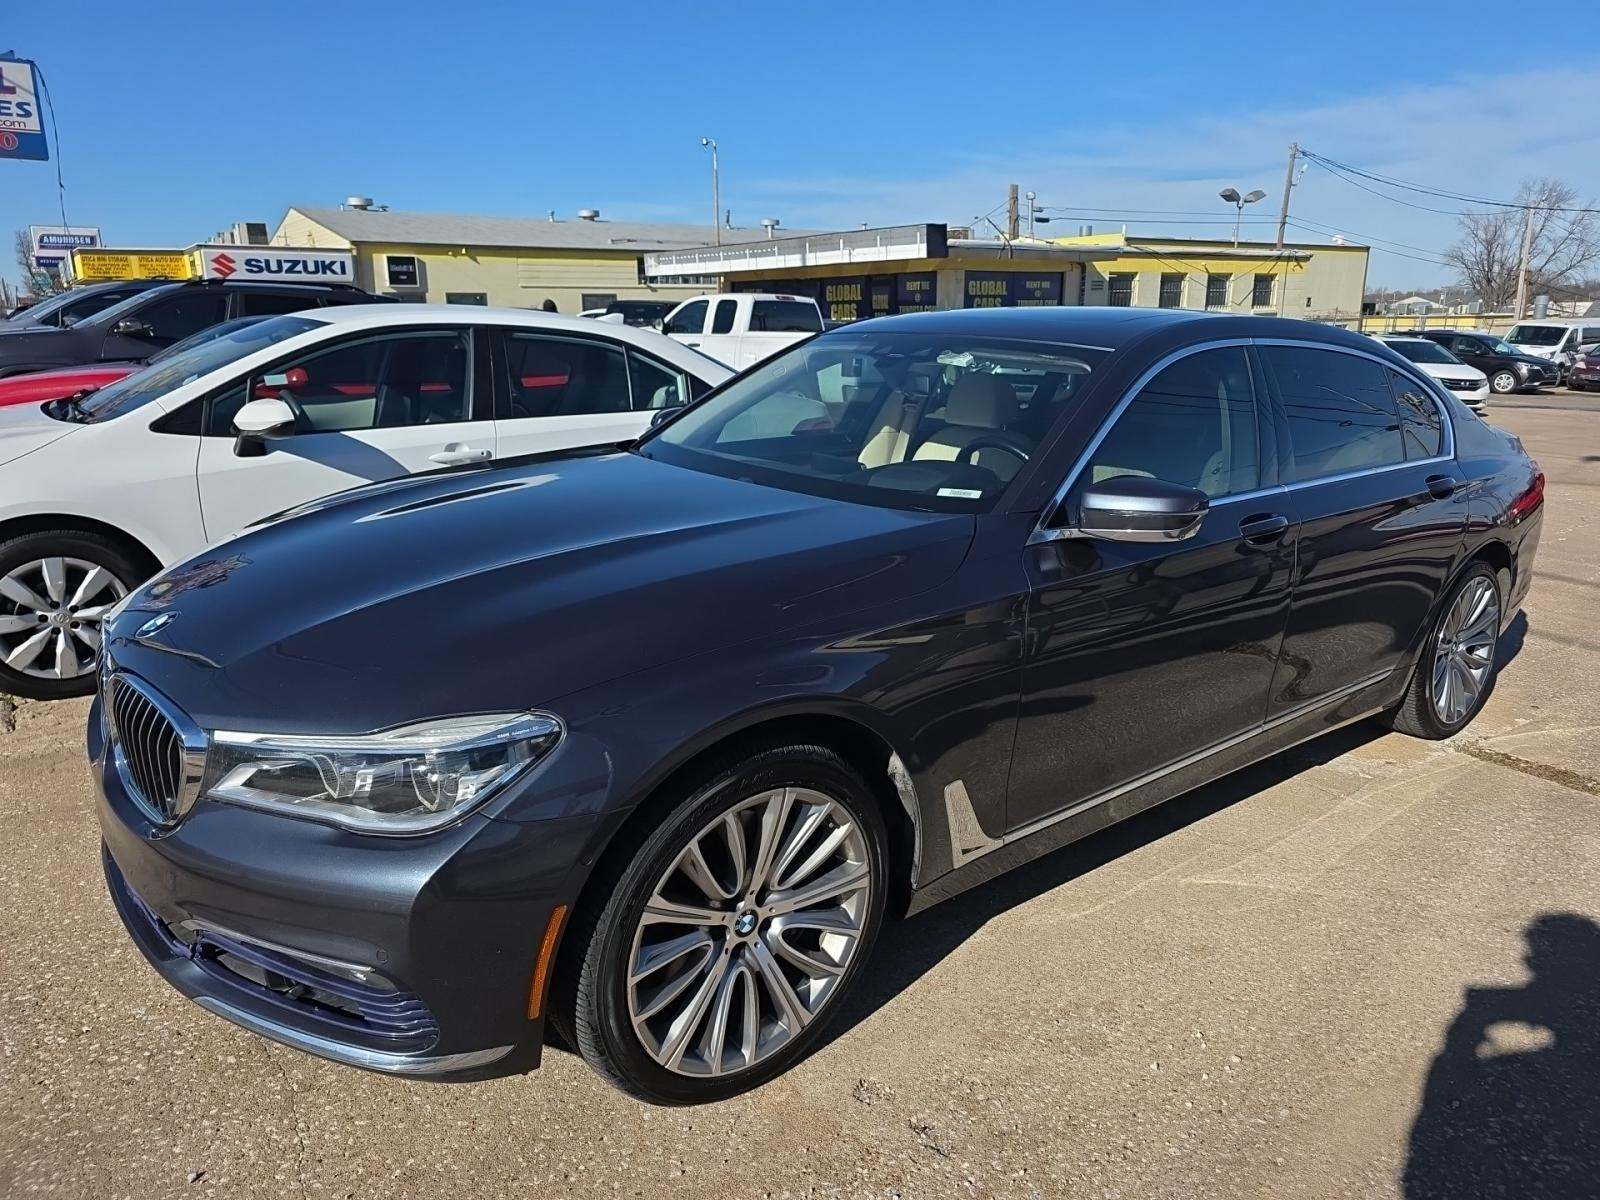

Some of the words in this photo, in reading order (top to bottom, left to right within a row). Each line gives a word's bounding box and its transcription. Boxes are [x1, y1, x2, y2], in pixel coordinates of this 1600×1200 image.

[43, 235, 91, 244] AMUNDSEN
[244, 258, 347, 276] SUZUKI
[826, 284, 862, 301] GLOBAL
[968, 280, 1008, 296] GLOBAL
[831, 303, 857, 320] CARS
